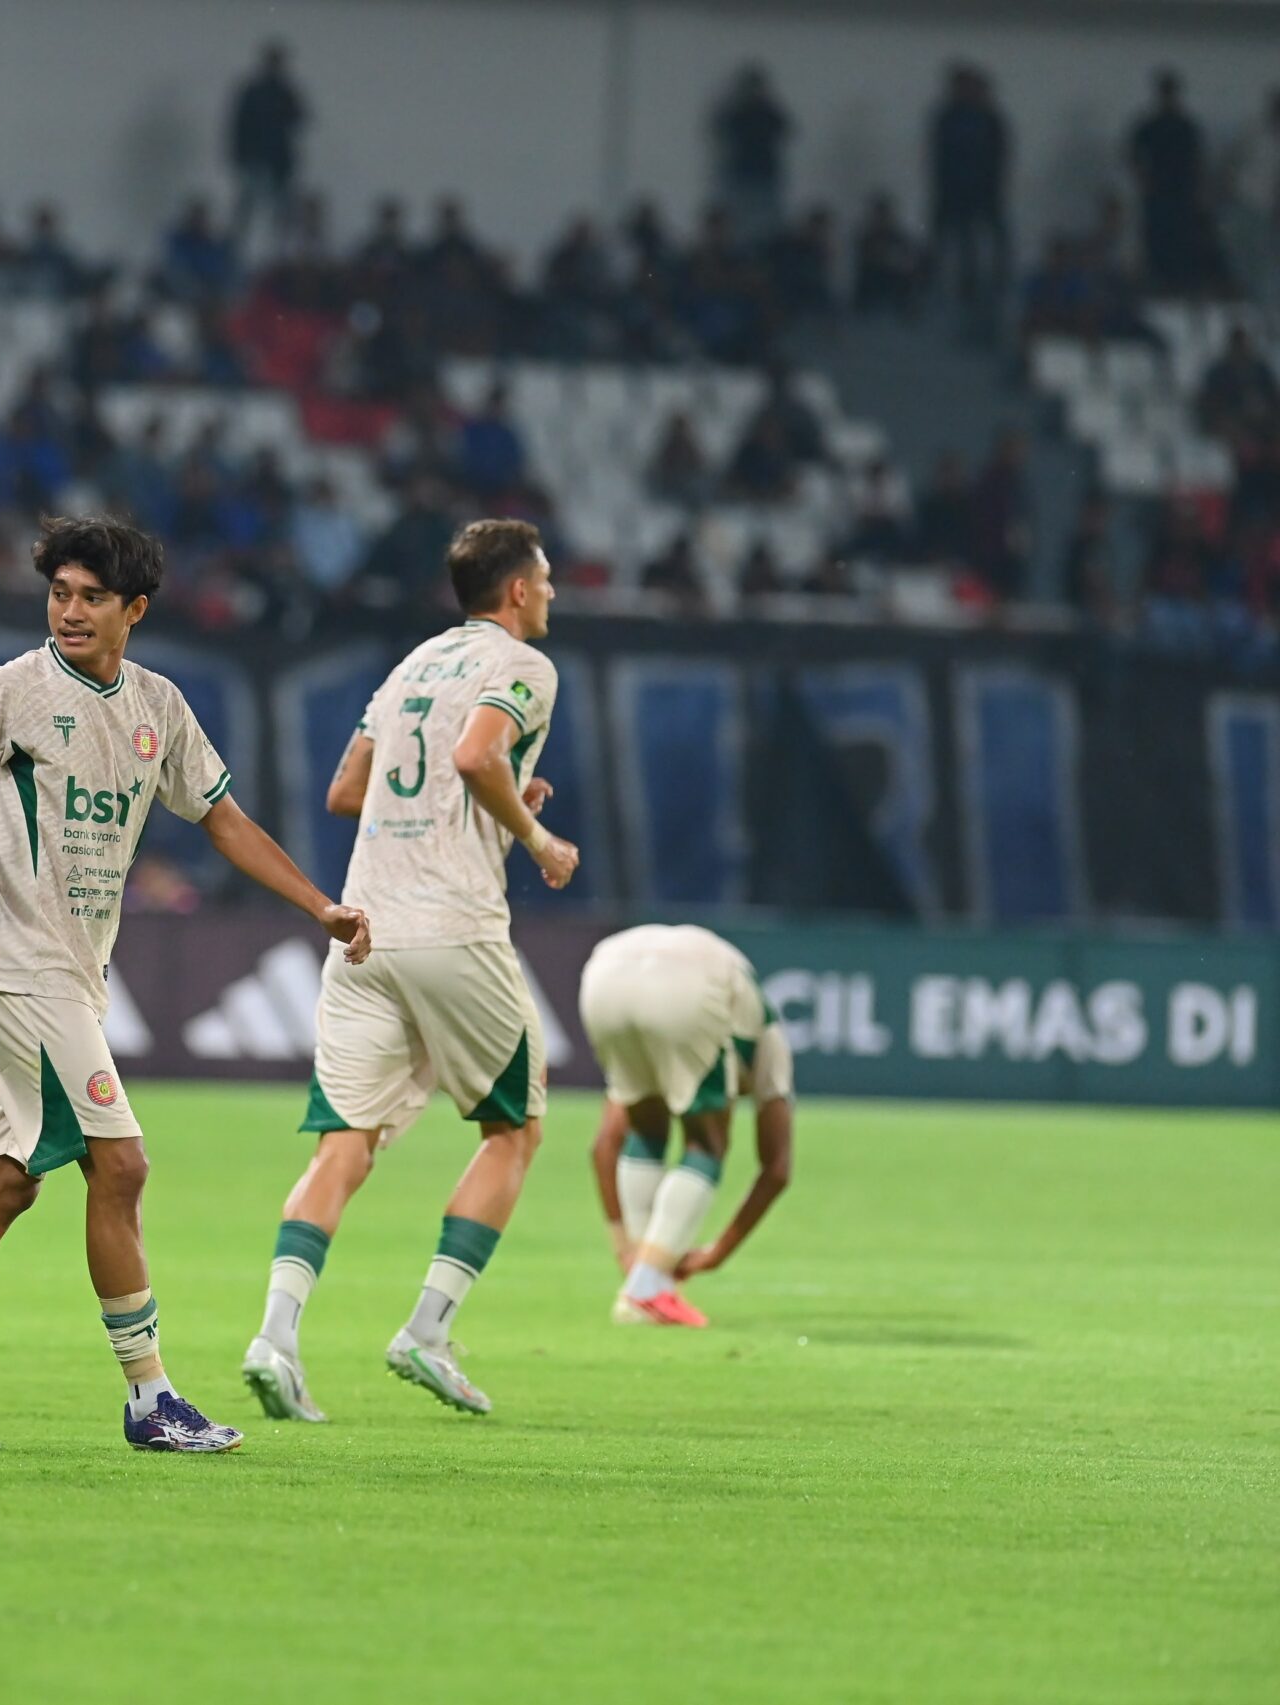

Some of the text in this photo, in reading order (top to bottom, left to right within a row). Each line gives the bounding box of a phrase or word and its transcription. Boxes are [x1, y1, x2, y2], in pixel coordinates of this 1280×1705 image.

[52, 715, 76, 724] TROPS
[386, 697, 434, 798] 3
[65, 776, 130, 827] bsn
[63, 827, 121, 844] bank syaria
[62, 844, 105, 857] nasional
[84, 867, 97, 876] THE
[910, 973, 1147, 1065] EMAS
[1168, 981, 1256, 1067] DI
